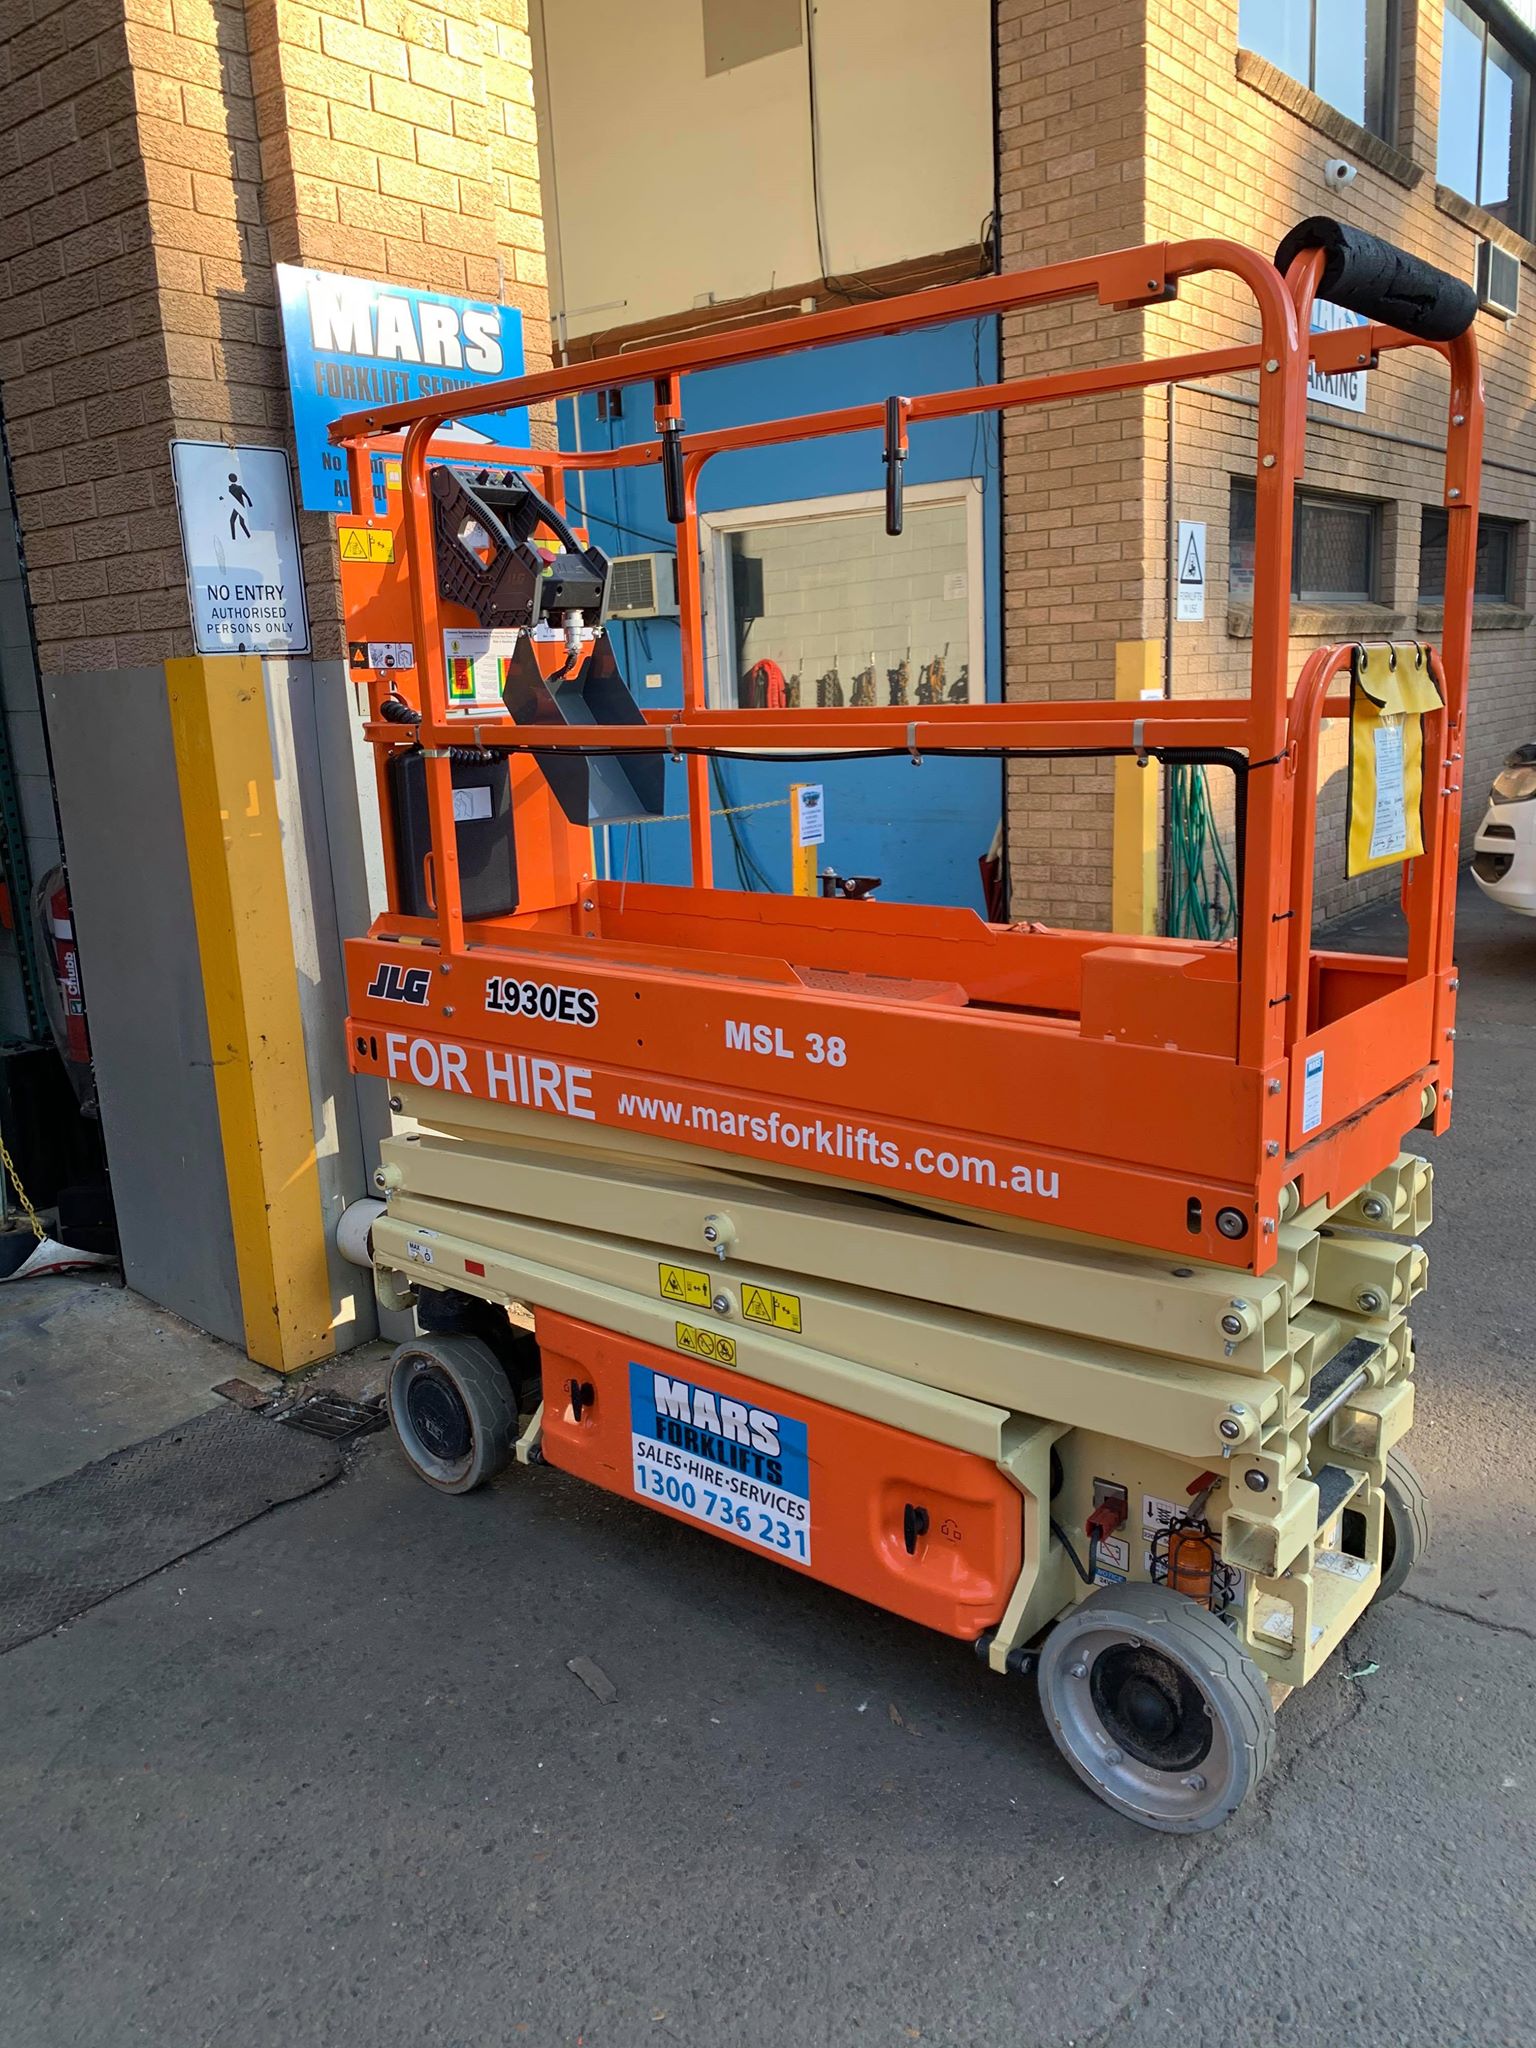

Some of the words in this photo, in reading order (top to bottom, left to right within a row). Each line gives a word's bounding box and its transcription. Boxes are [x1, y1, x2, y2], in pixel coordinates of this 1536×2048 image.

[306, 281, 504, 375] MARS
[314, 360, 410, 403] FORKLIFT
[1307, 362, 1358, 401] ARKING
[322, 452, 342, 471] No
[207, 585, 230, 601] NO
[235, 585, 284, 601] ENTRY
[211, 607, 287, 619] AUTHORISED
[207, 623, 261, 634] PERSONS
[265, 623, 294, 633] ONLY
[367, 964, 431, 1006] JLG
[486, 976, 599, 1027] 1930ES
[725, 1020, 794, 1059] MSL
[805, 1033, 847, 1067] 38
[386, 1033, 472, 1094] FOR
[486, 1050, 596, 1120] HIRE
[618, 1093, 1059, 1199] www.marsforklifts.com.au
[653, 1372, 782, 1457] MARS
[656, 1416, 782, 1486] FORKLIFTS
[637, 1465, 696, 1509] 1300
[703, 1492, 751, 1532] 736
[759, 1514, 806, 1557] 231
